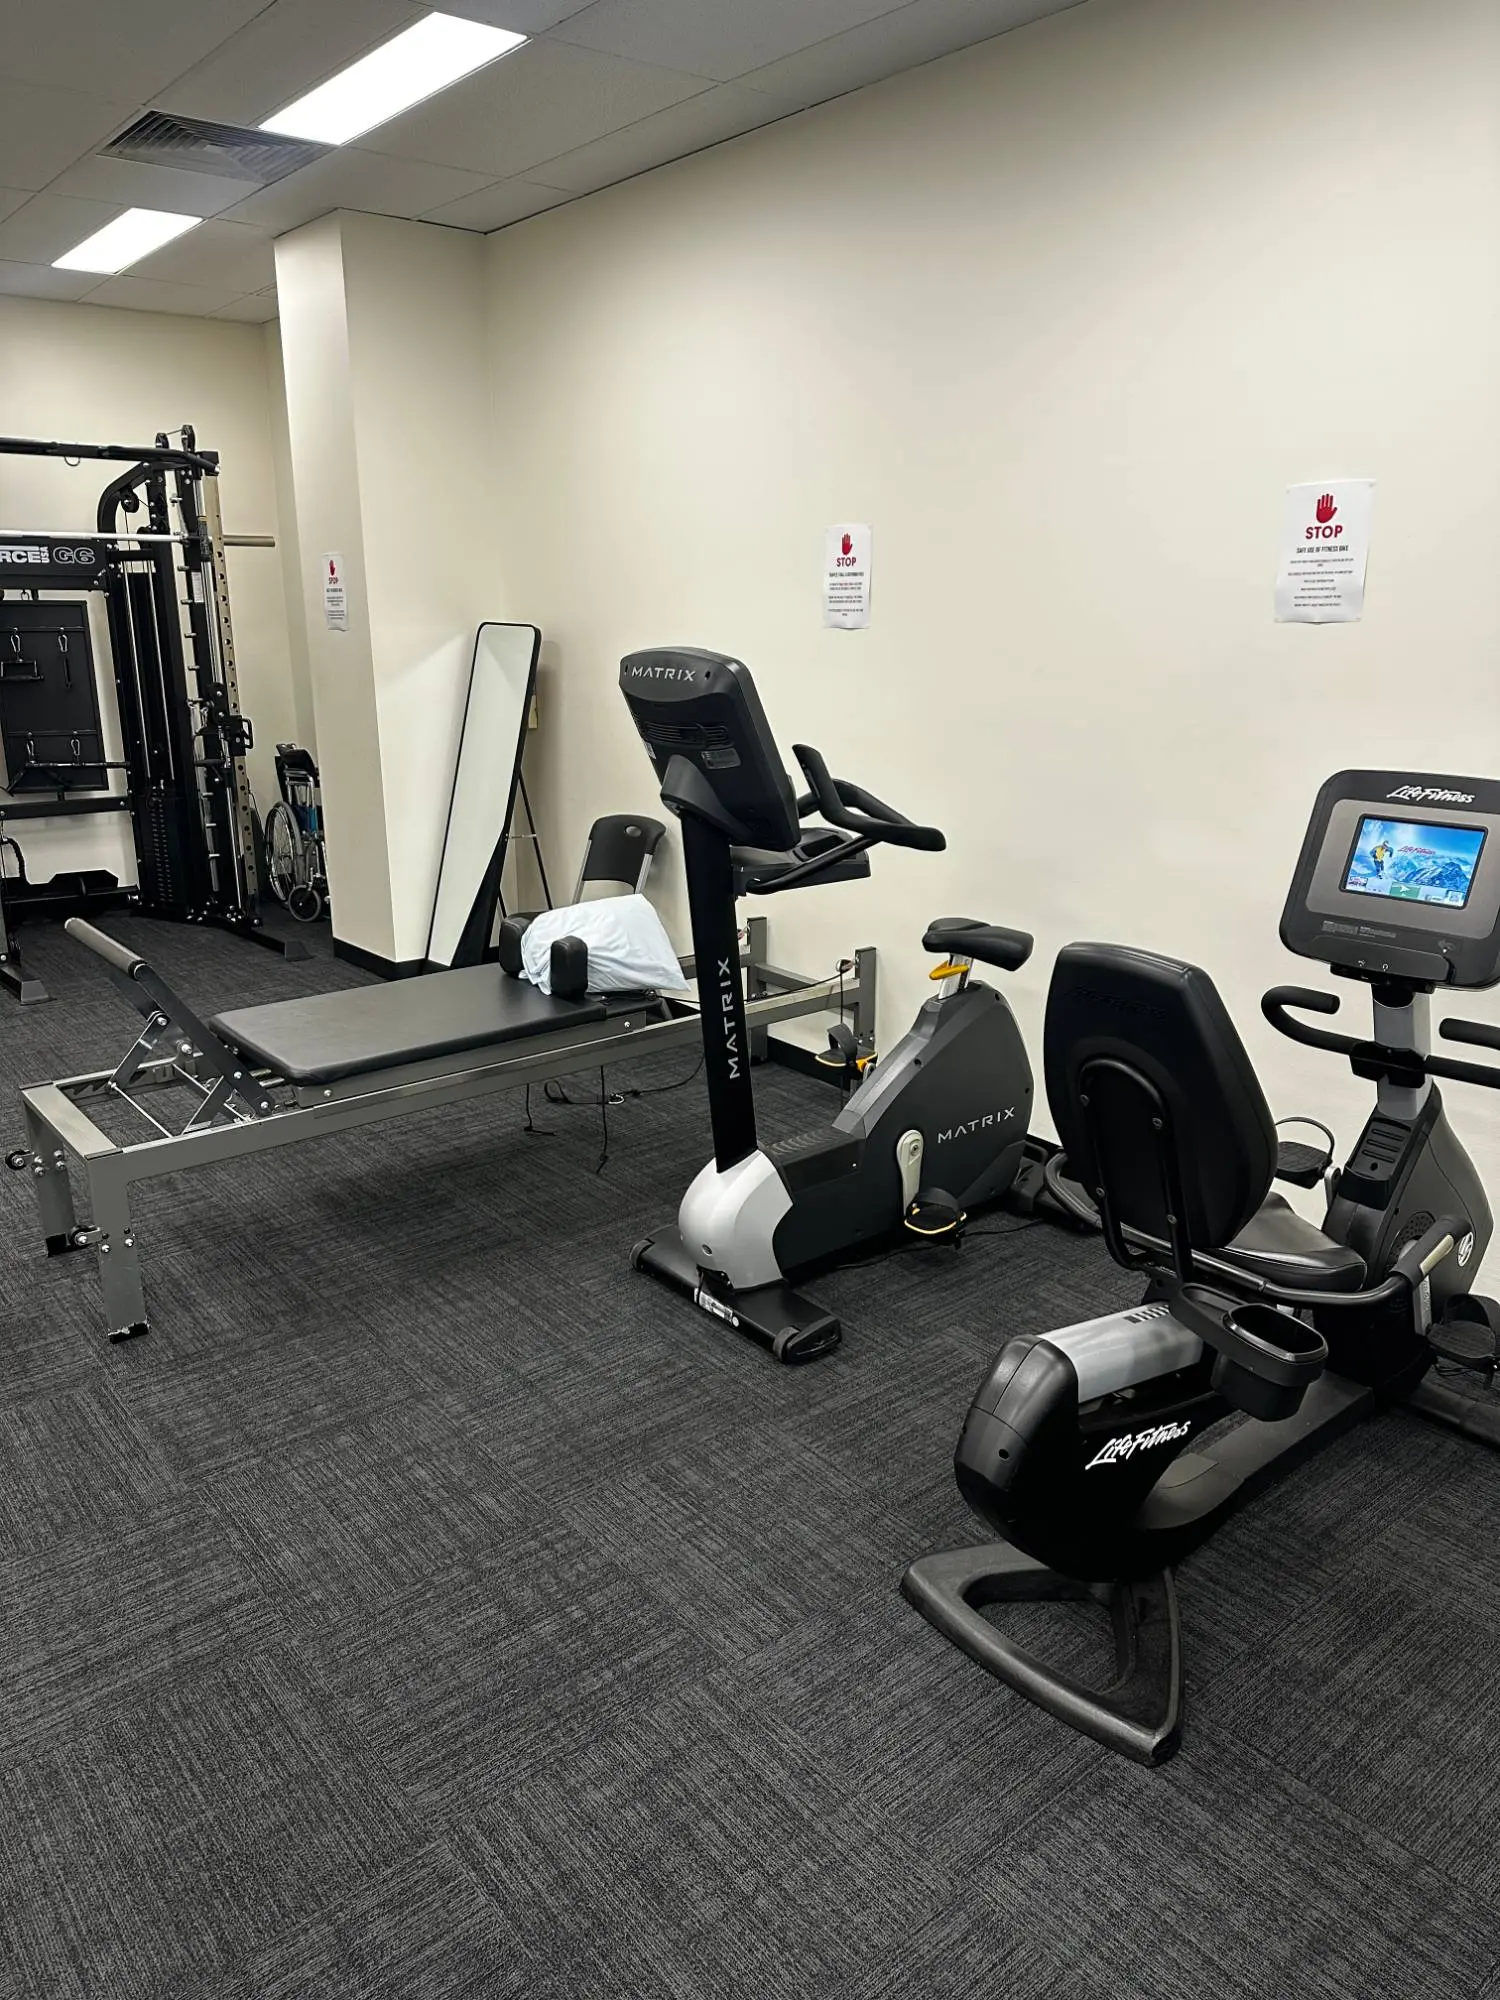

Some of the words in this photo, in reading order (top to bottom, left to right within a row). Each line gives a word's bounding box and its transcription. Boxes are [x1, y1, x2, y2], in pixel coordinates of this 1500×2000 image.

[1305, 525, 1343, 540] STOP
[53, 547, 96, 564] G6
[836, 557, 857, 567] STOP
[631, 666, 696, 682] MATRIX
[717, 957, 741, 1079] MATRIX
[937, 1106, 1015, 1144] MATRIX
